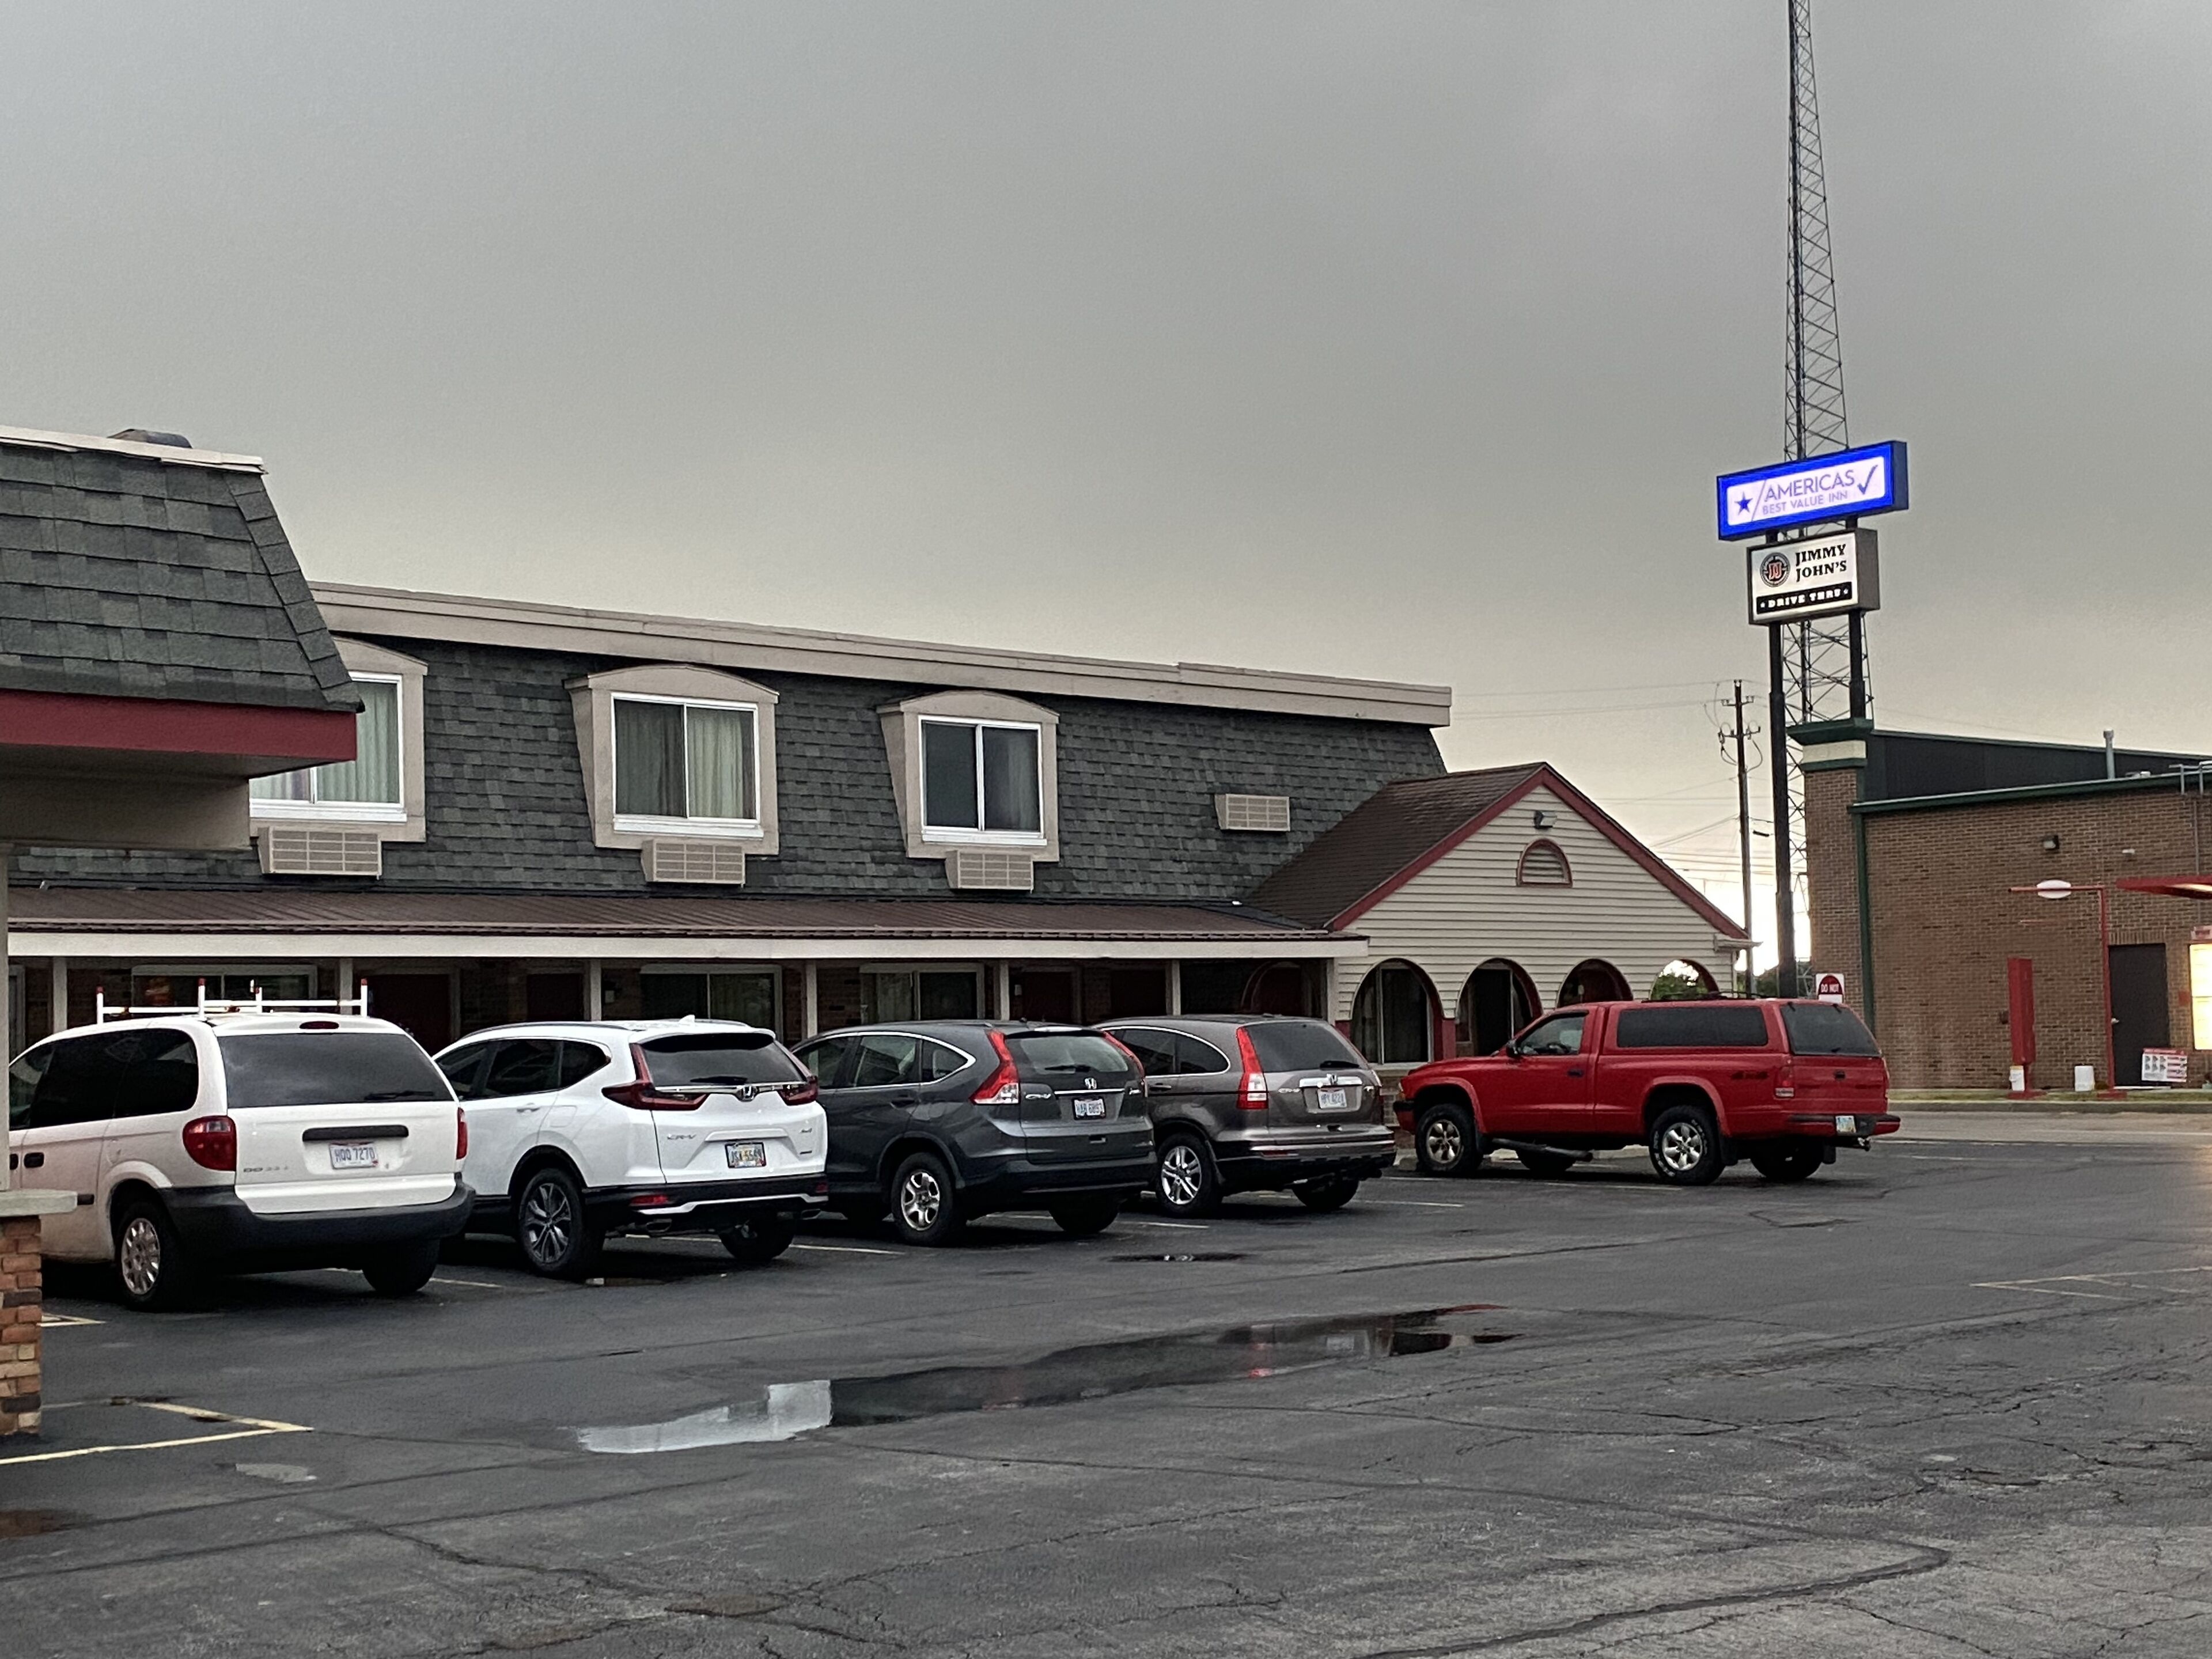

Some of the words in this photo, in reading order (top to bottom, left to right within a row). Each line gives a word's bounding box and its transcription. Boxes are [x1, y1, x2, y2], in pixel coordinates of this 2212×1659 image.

[1765, 469, 1854, 501] AMERICAS
[1763, 502, 1786, 514] BEST
[1791, 495, 1824, 508] VALUE
[1828, 491, 1847, 502] INN
[1796, 544, 1846, 566] JIMMY
[1796, 560, 1846, 582] JOHN'S
[1768, 595, 1805, 608] DRIVE
[1809, 589, 1841, 602] THRU
